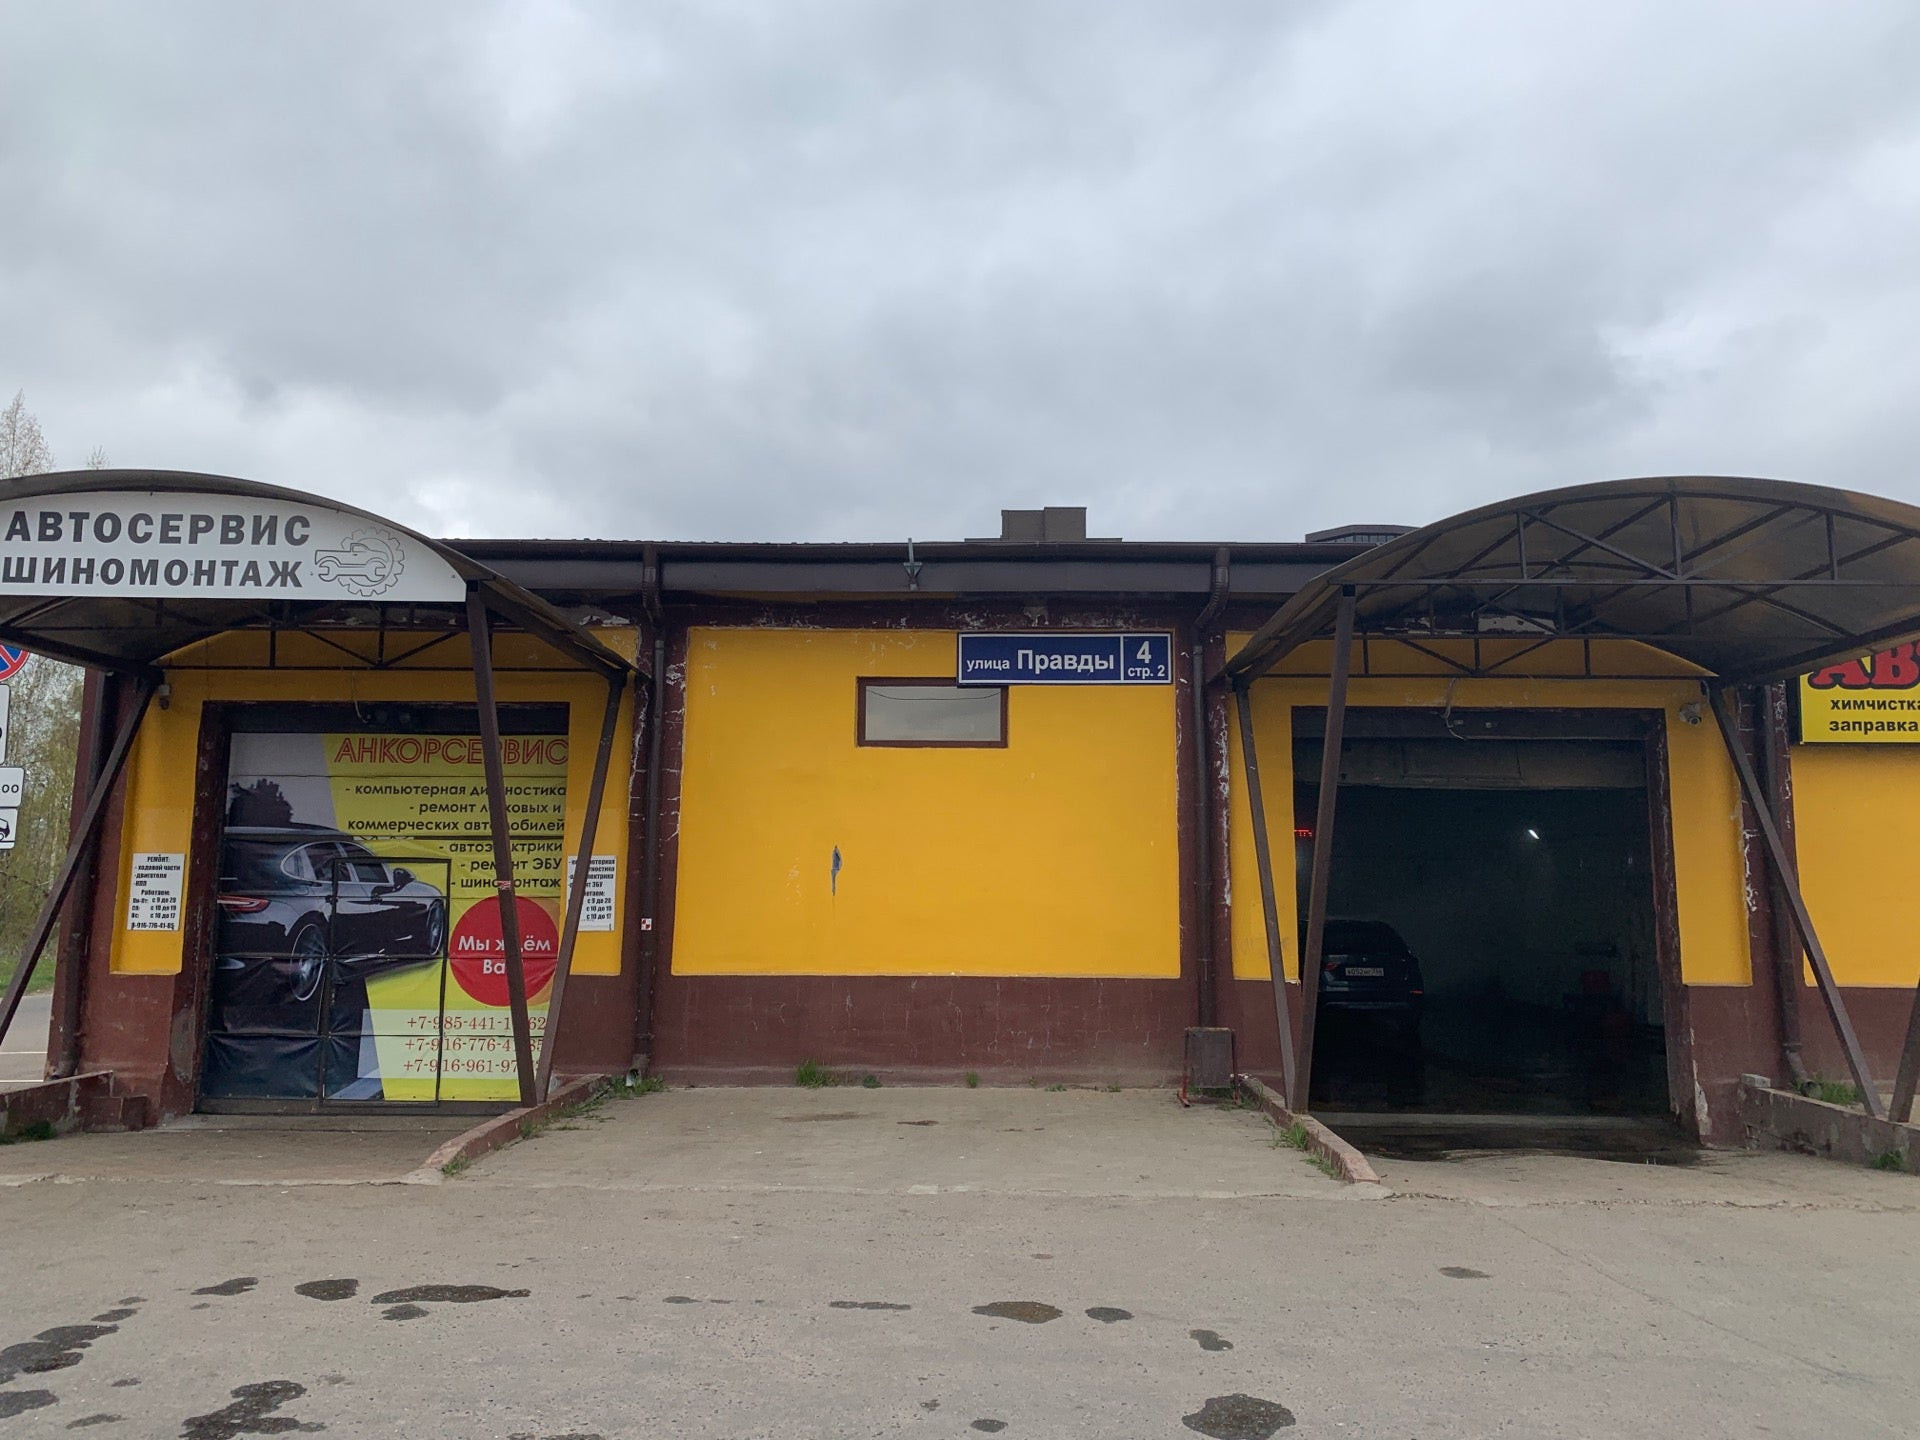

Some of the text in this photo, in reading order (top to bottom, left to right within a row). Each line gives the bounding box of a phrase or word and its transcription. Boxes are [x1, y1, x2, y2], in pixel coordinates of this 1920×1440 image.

[5, 511, 311, 546] АВТОСЕРВИС
[2, 557, 303, 588] ШИНОМОНТАЖ
[1136, 640, 1152, 663] 4
[967, 649, 1114, 675] улица Правды
[1128, 665, 1165, 679] стр. 2
[1830, 699, 1920, 711] химчистк
[1829, 720, 1919, 735] заправка
[334, 737, 569, 766] АНКОРСЕВИС
[355, 785, 466, 798] компьютерная
[470, 785, 567, 797] диностика
[419, 803, 476, 815] ремонт
[553, 803, 561, 814] и
[348, 819, 565, 833] коммерческих автобилей
[450, 842, 563, 855] автоэктрики
[532, 858, 562, 870] ЭБУ
[460, 877, 561, 888] шиноонтаж
[457, 935, 490, 951] Мы
[482, 959, 506, 974] Ва
